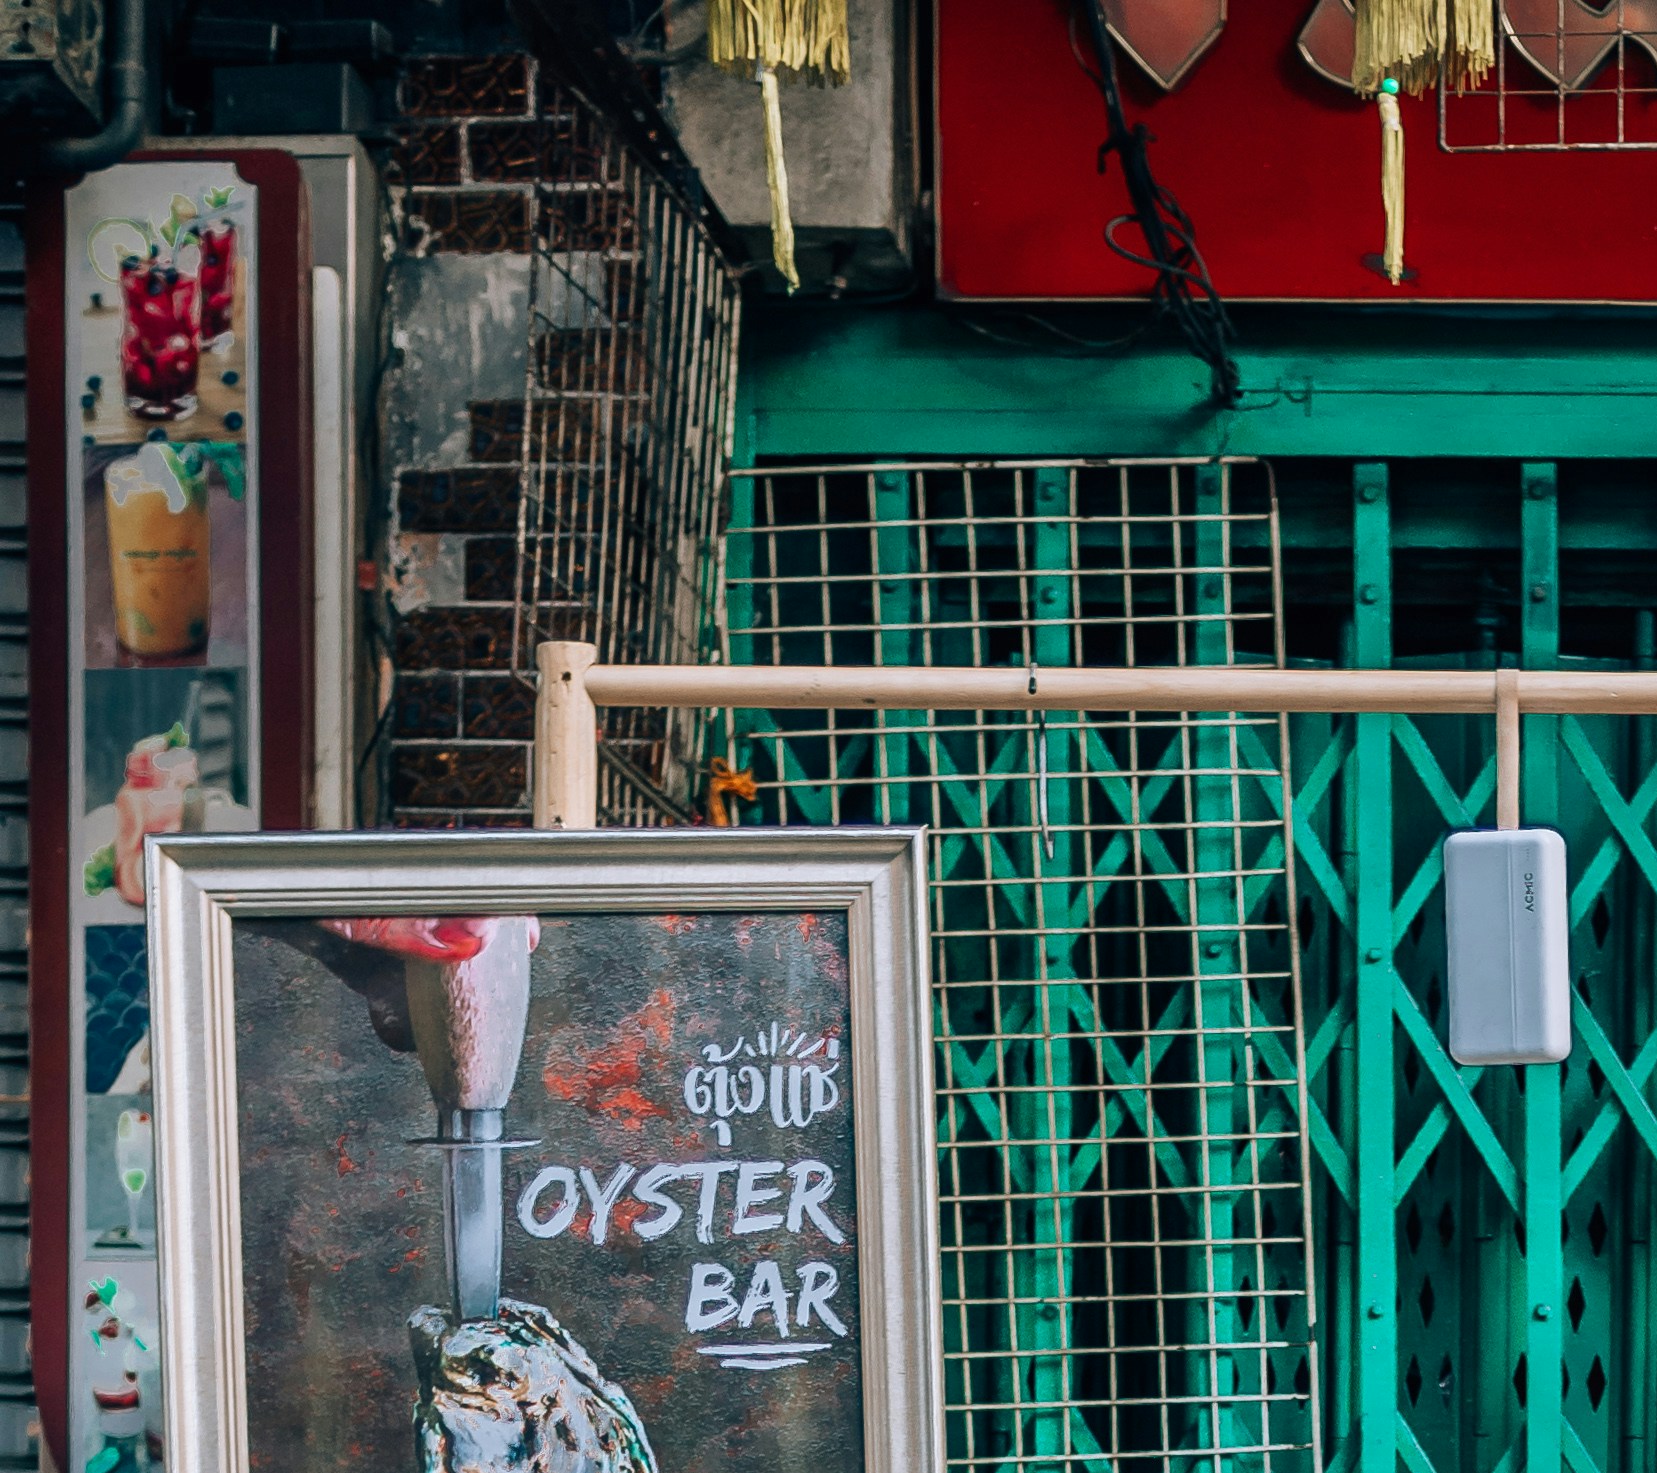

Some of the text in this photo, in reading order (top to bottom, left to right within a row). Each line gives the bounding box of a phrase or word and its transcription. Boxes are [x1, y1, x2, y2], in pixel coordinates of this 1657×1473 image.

[1523, 872, 1534, 912] ACMIC
[516, 1161, 847, 1246] OYSTER
[685, 1261, 848, 1338] BAR
